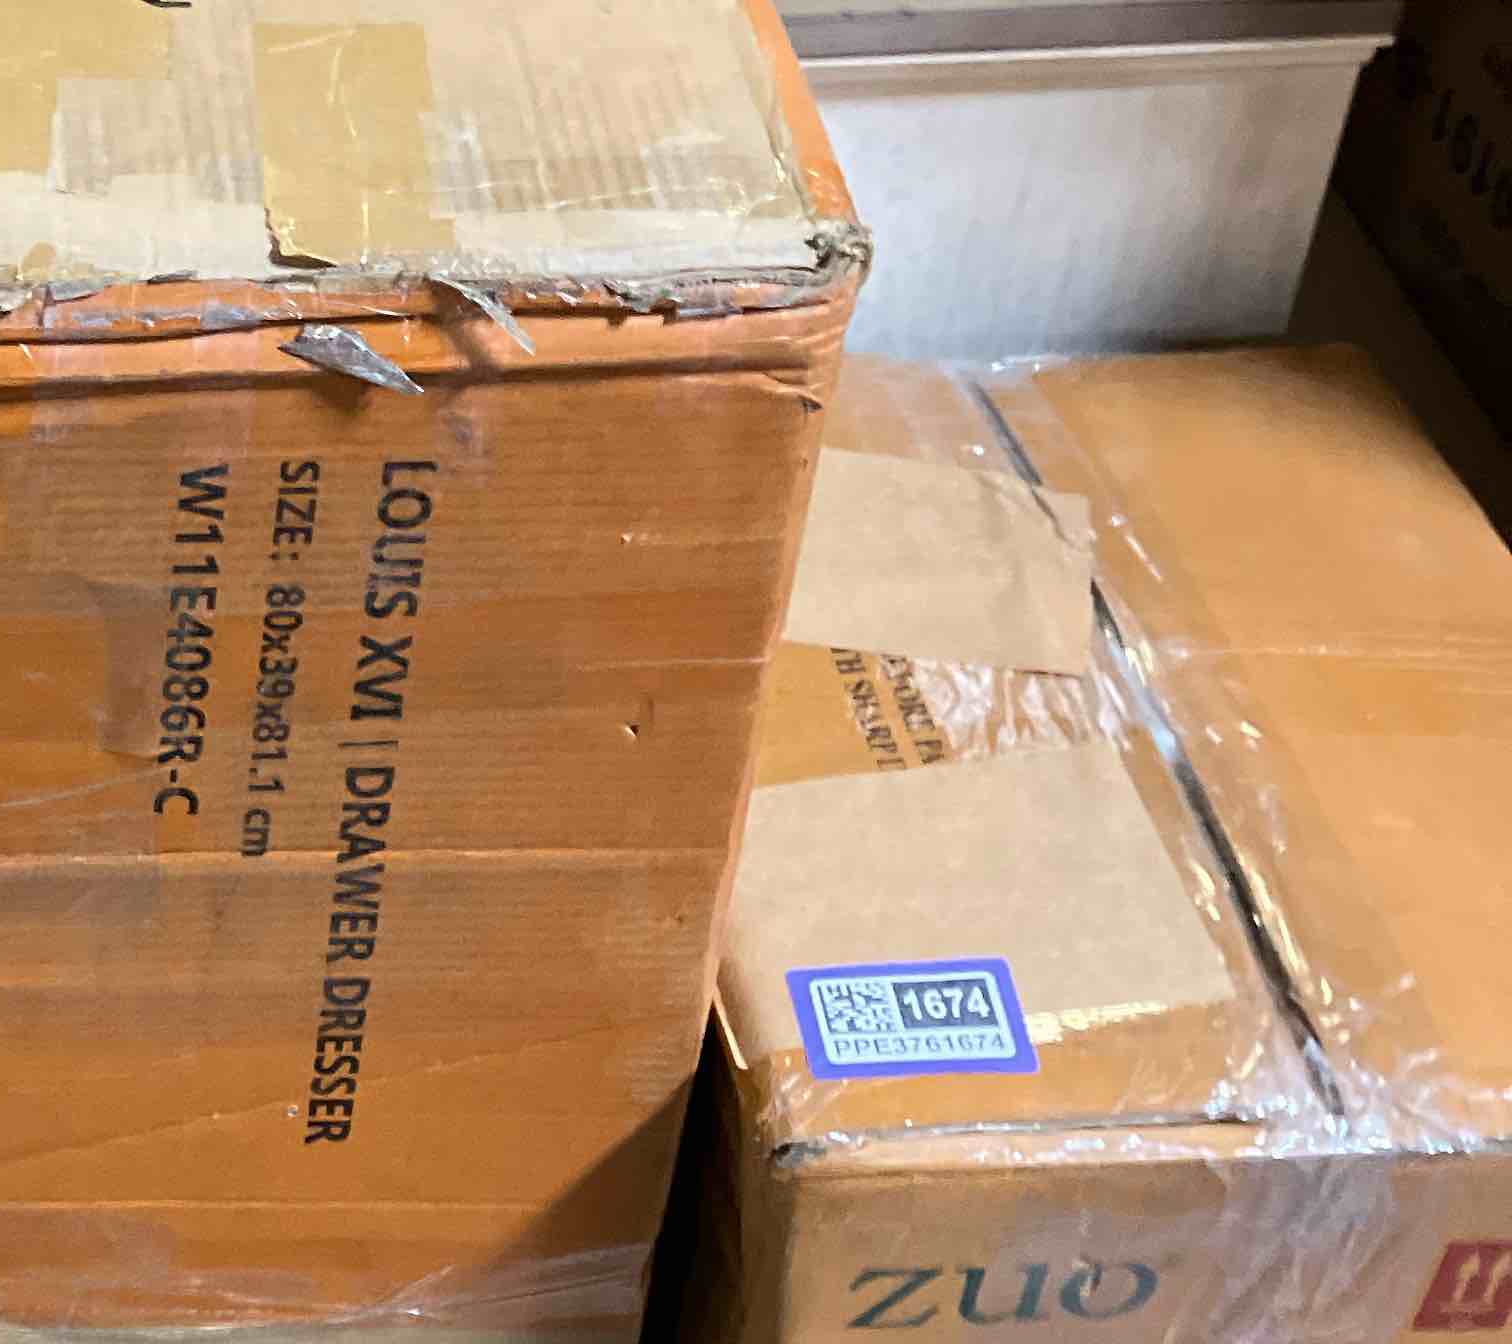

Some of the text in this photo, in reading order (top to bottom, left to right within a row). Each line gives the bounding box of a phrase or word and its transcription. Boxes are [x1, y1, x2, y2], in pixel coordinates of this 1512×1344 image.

[364, 460, 437, 619] LOUIS
[152, 463, 231, 816] W11E4086R-C
[248, 582, 307, 793] 80x39x81.1
[350, 634, 414, 721] XVI
[241, 808, 272, 858] cm
[325, 765, 395, 965] DRAWER
[304, 977, 372, 1145] DRESSER
[832, 1032, 1005, 1056] PPE3761674
[901, 985, 990, 1021] 1674
